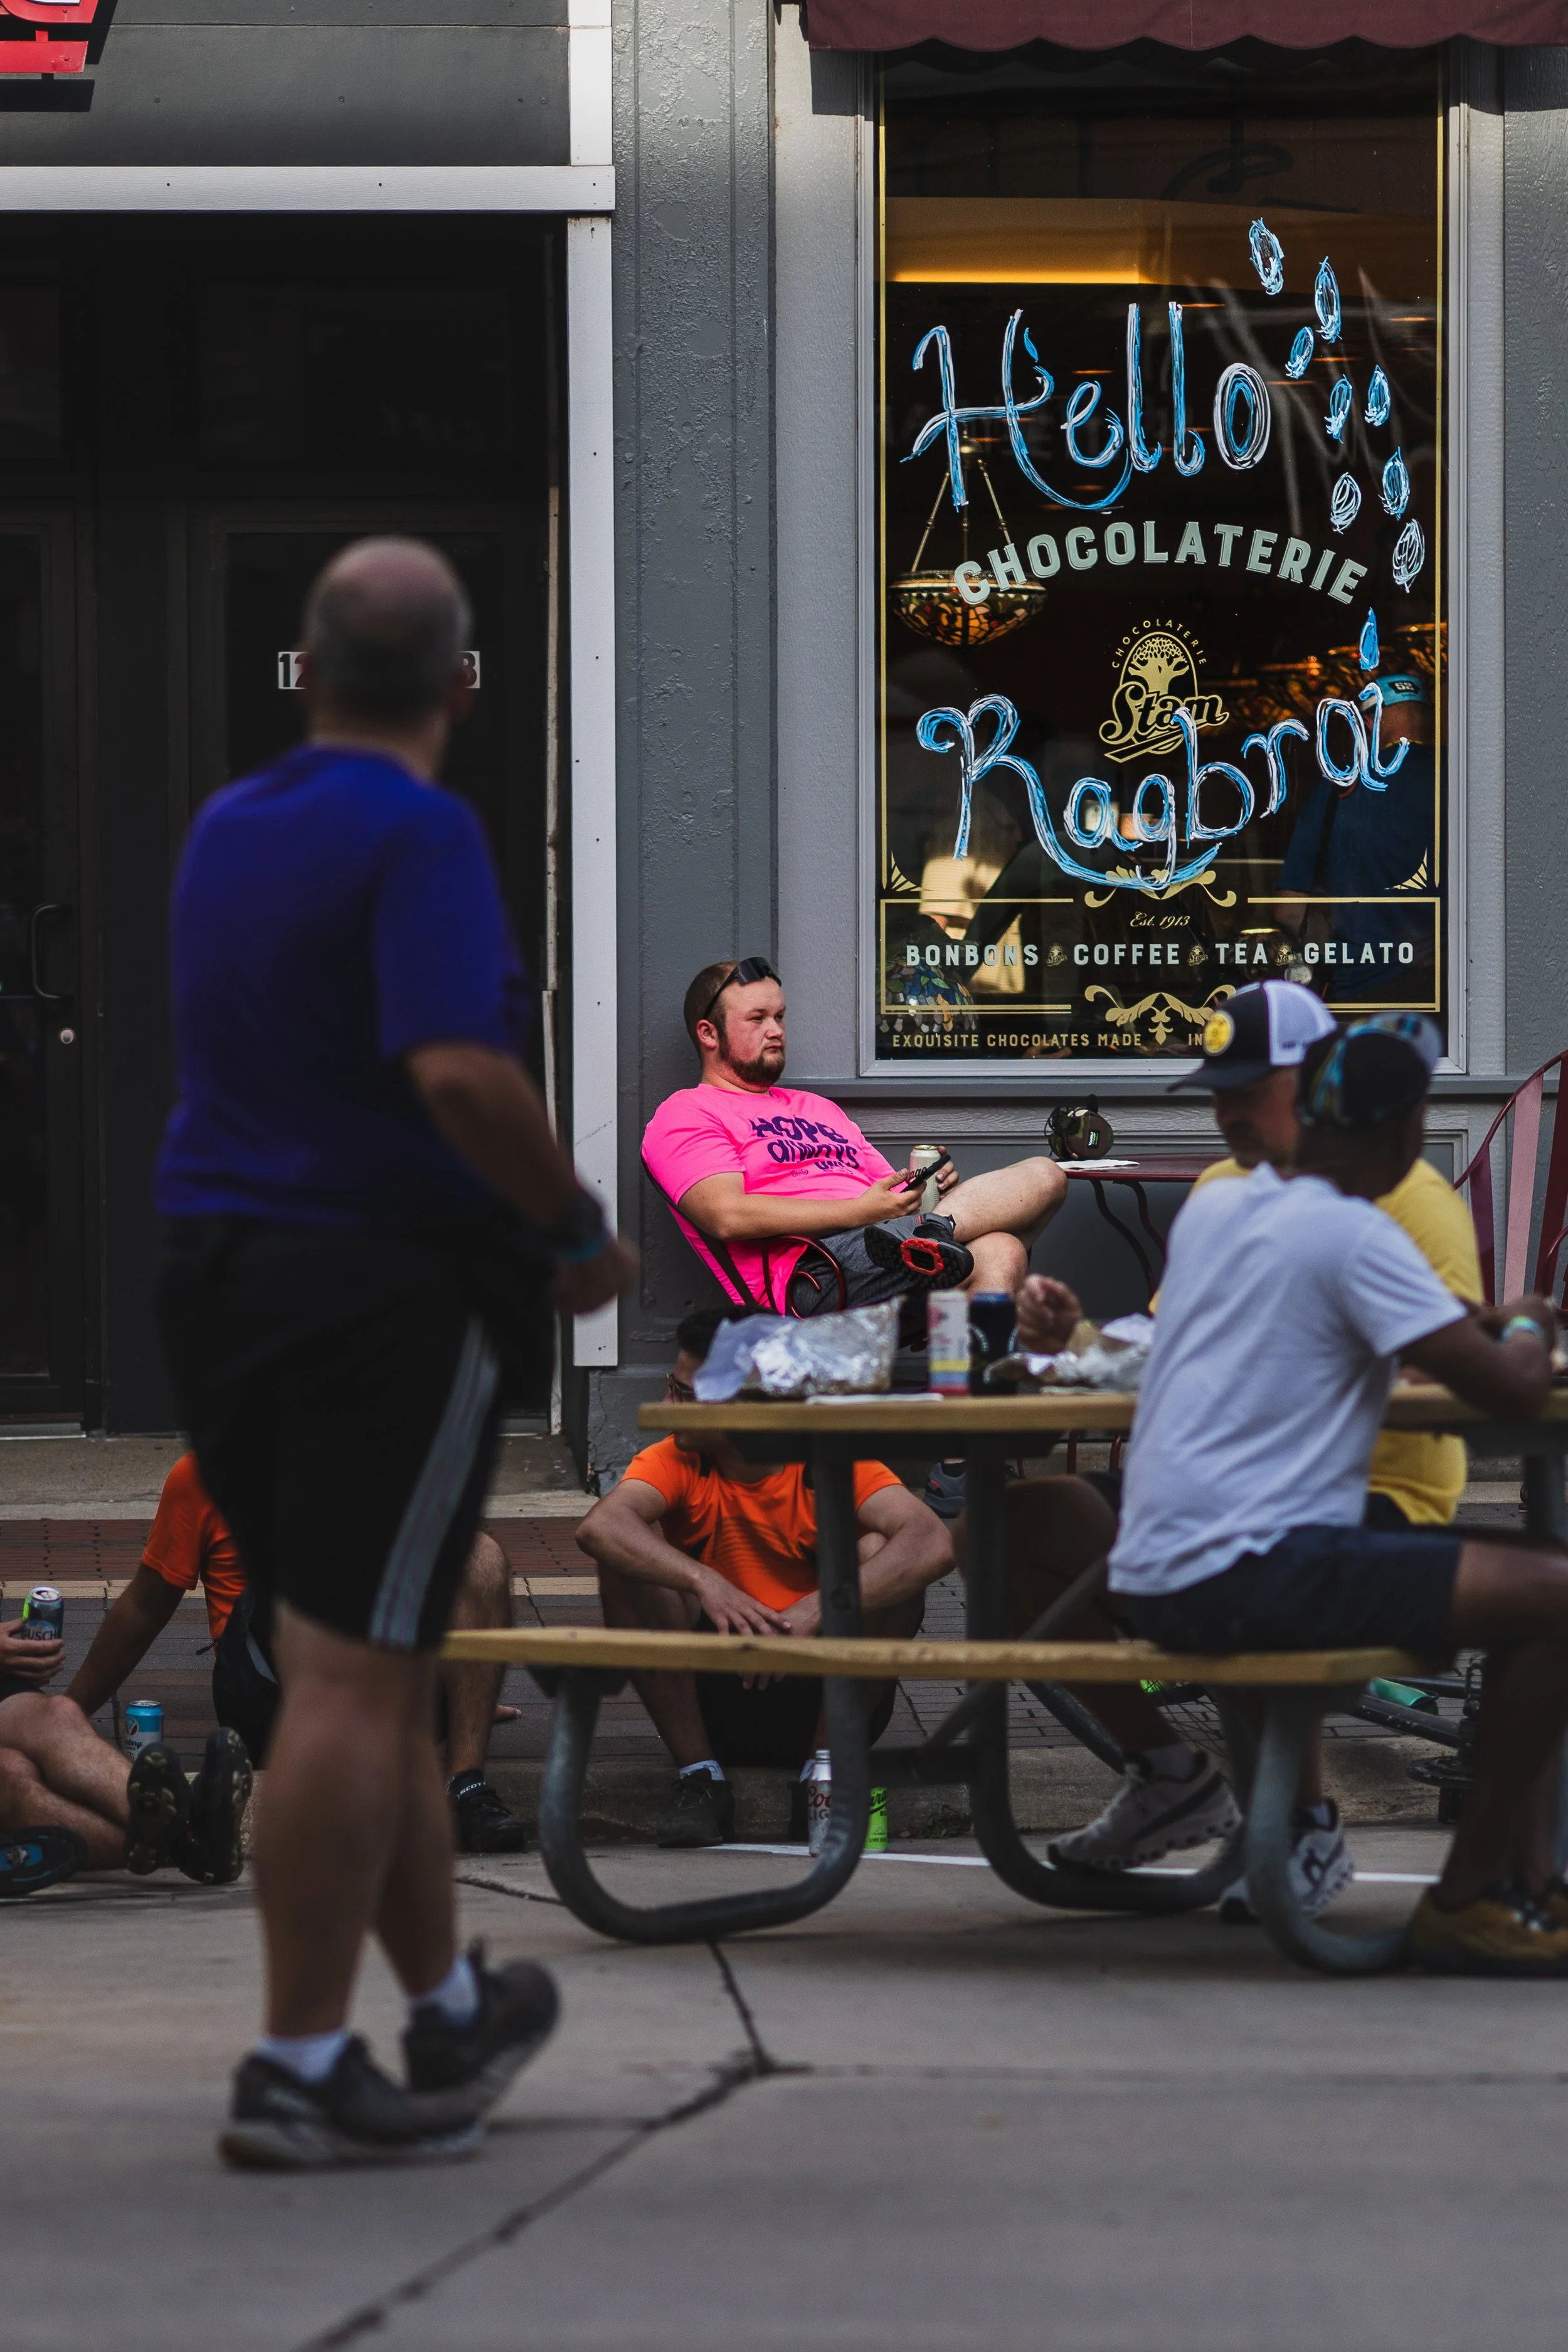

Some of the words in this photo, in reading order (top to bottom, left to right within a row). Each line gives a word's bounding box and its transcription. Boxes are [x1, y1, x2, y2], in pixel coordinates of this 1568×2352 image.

[901, 302, 1271, 514] Hello
[953, 521, 1368, 605] CHOCOLATERIE
[1111, 618, 1207, 669] CHOCOLATERIE
[1099, 681, 1230, 746] Stam
[1130, 911, 1155, 928] Est.
[1158, 916, 1191, 930] 1913
[906, 945, 1039, 967] BONBONS
[1073, 943, 1180, 965] COFFEE
[1215, 943, 1268, 965] TEA
[1303, 942, 1414, 965] GELATO
[893, 1034, 978, 1047] EXQUISITE
[987, 1033, 1089, 1047] CHOCOLATES
[1098, 1033, 1142, 1046] MADE
[1188, 1033, 1203, 1046] IN
